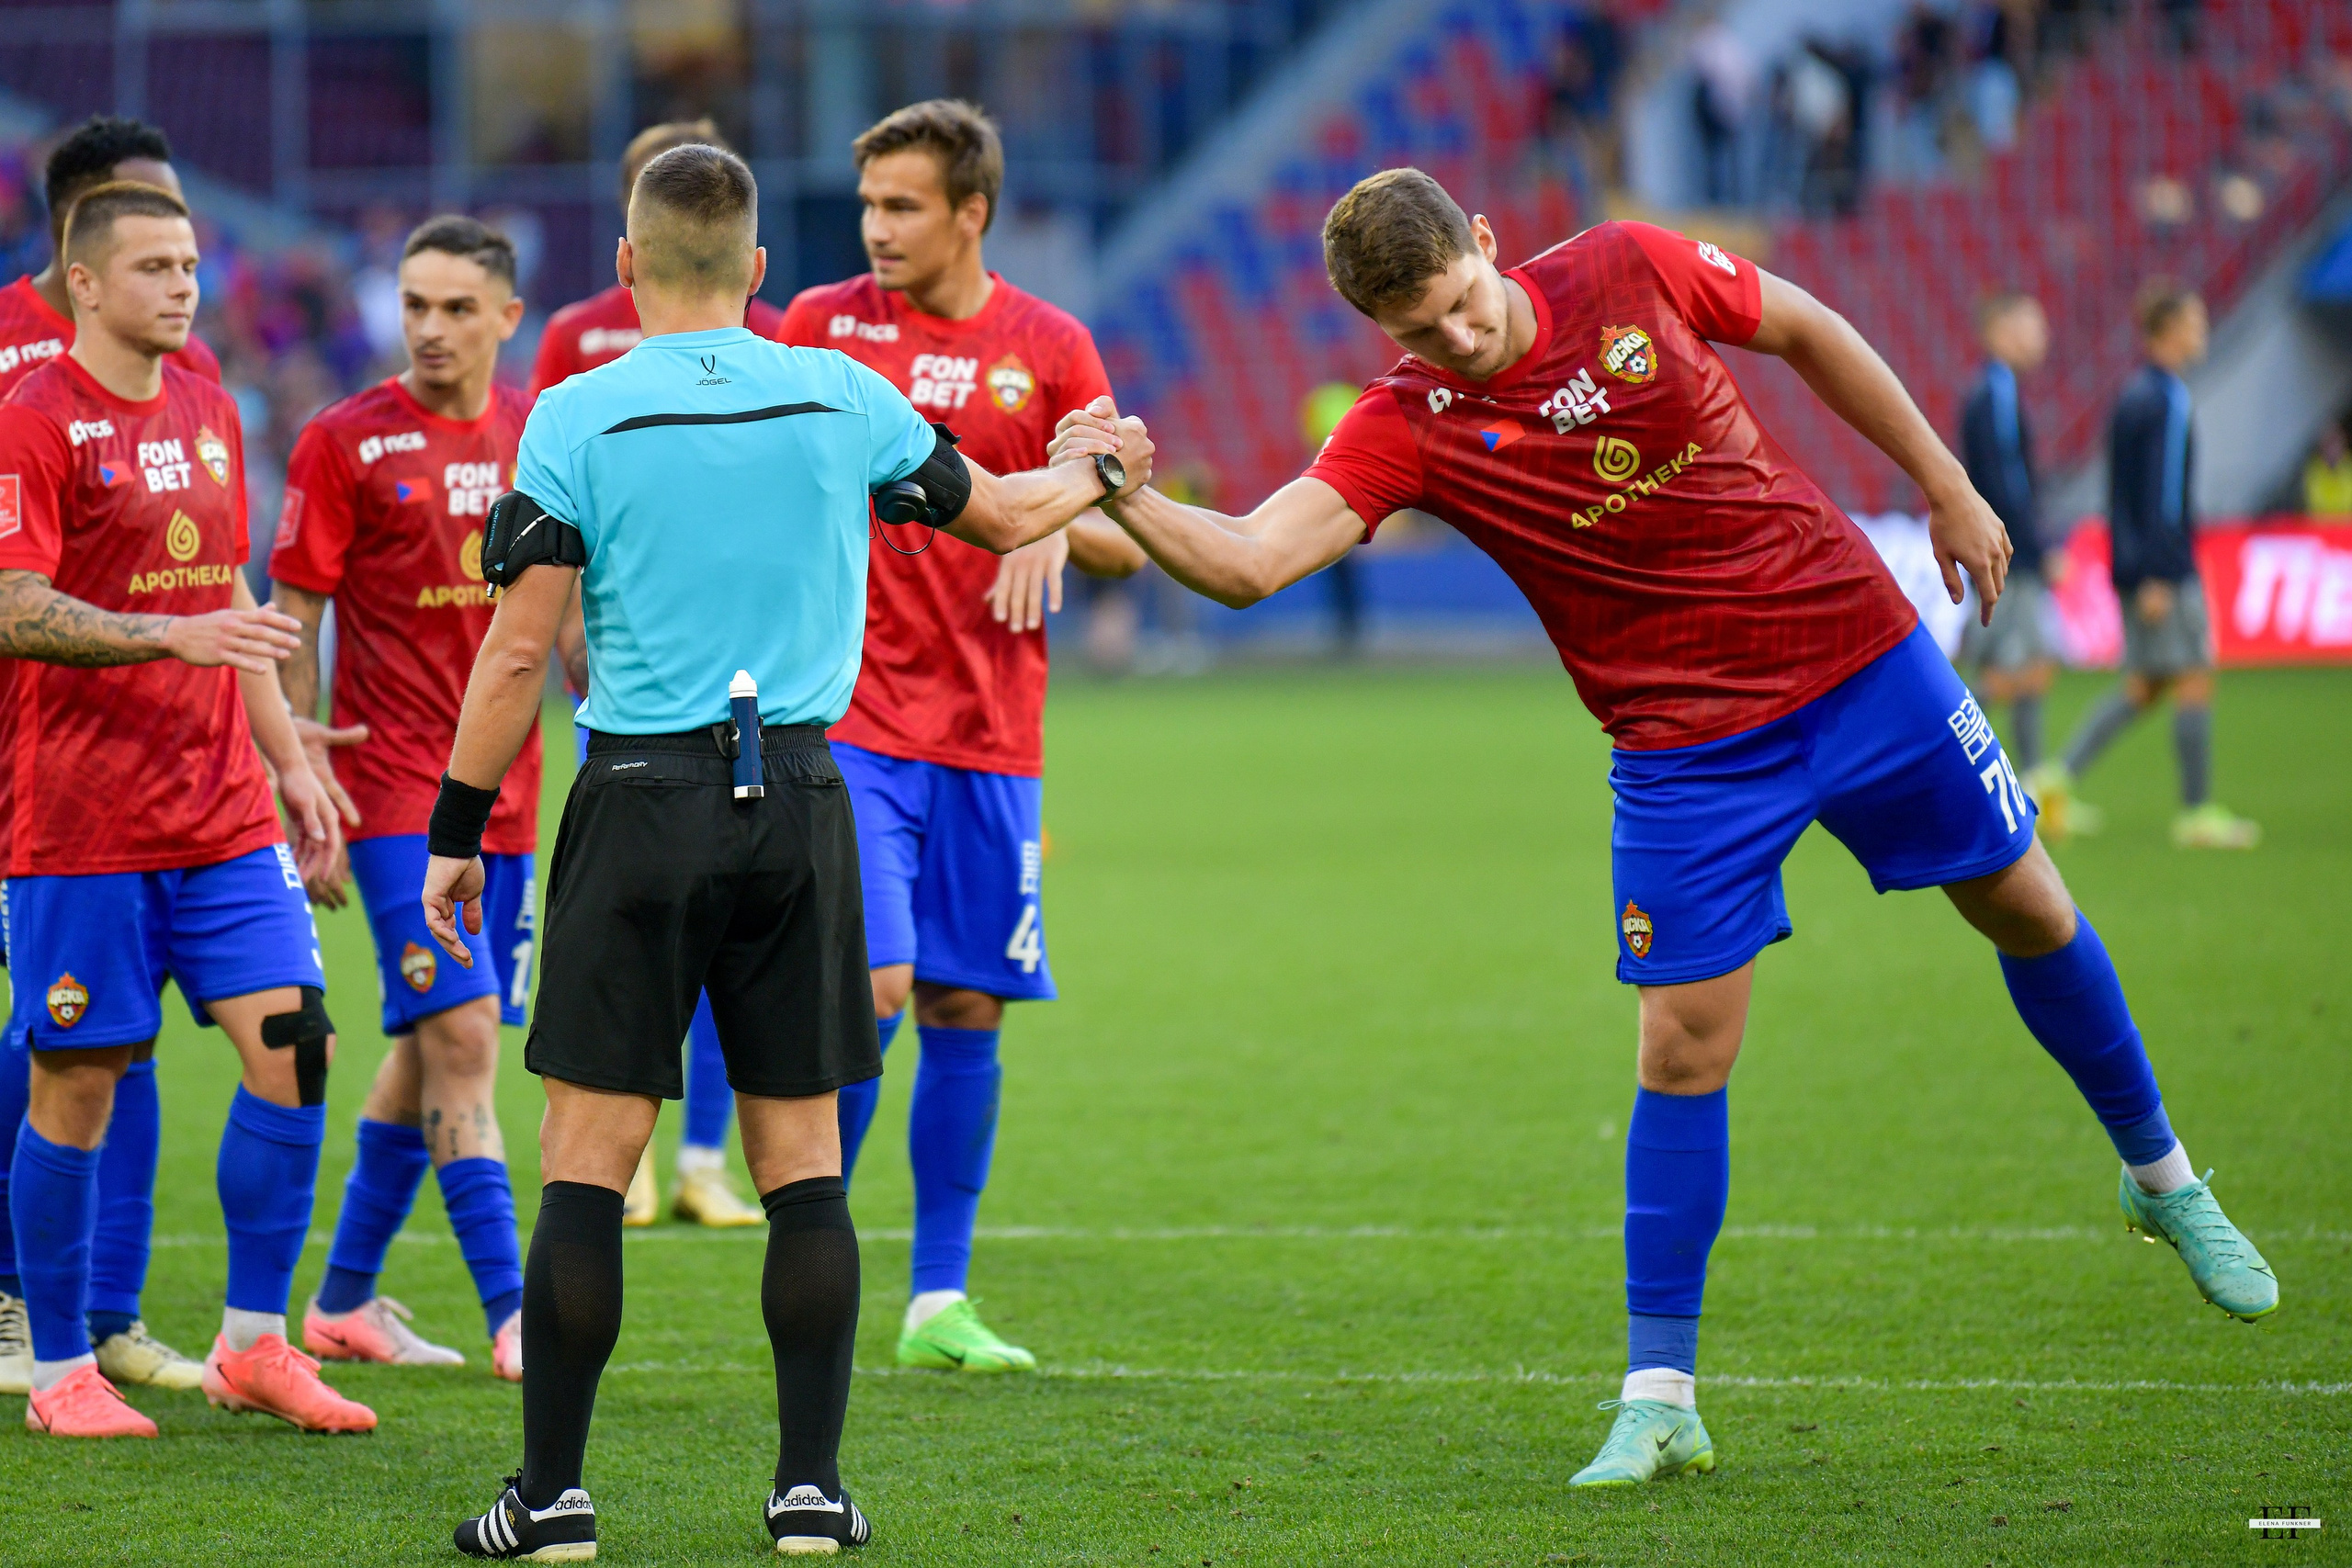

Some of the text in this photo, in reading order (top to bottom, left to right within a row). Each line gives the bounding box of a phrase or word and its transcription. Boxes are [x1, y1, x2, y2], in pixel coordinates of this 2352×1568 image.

[1606, 332, 1649, 372] ЦСКА
[695, 377, 732, 386] JÖGEL
[909, 353, 979, 383] FON
[909, 378, 978, 410] BET
[1551, 387, 1611, 435] BET
[137, 438, 184, 468] FON
[143, 460, 191, 493] BET
[444, 461, 500, 490] FON
[1571, 441, 1703, 530] APOTHEKA
[447, 486, 503, 516] BET
[128, 564, 232, 595] APOTHEKA
[1979, 748, 2027, 835] 78
[1005, 904, 1042, 974] 4
[1623, 917, 1651, 935] ЦСКА
[784, 1494, 826, 1507] adidas
